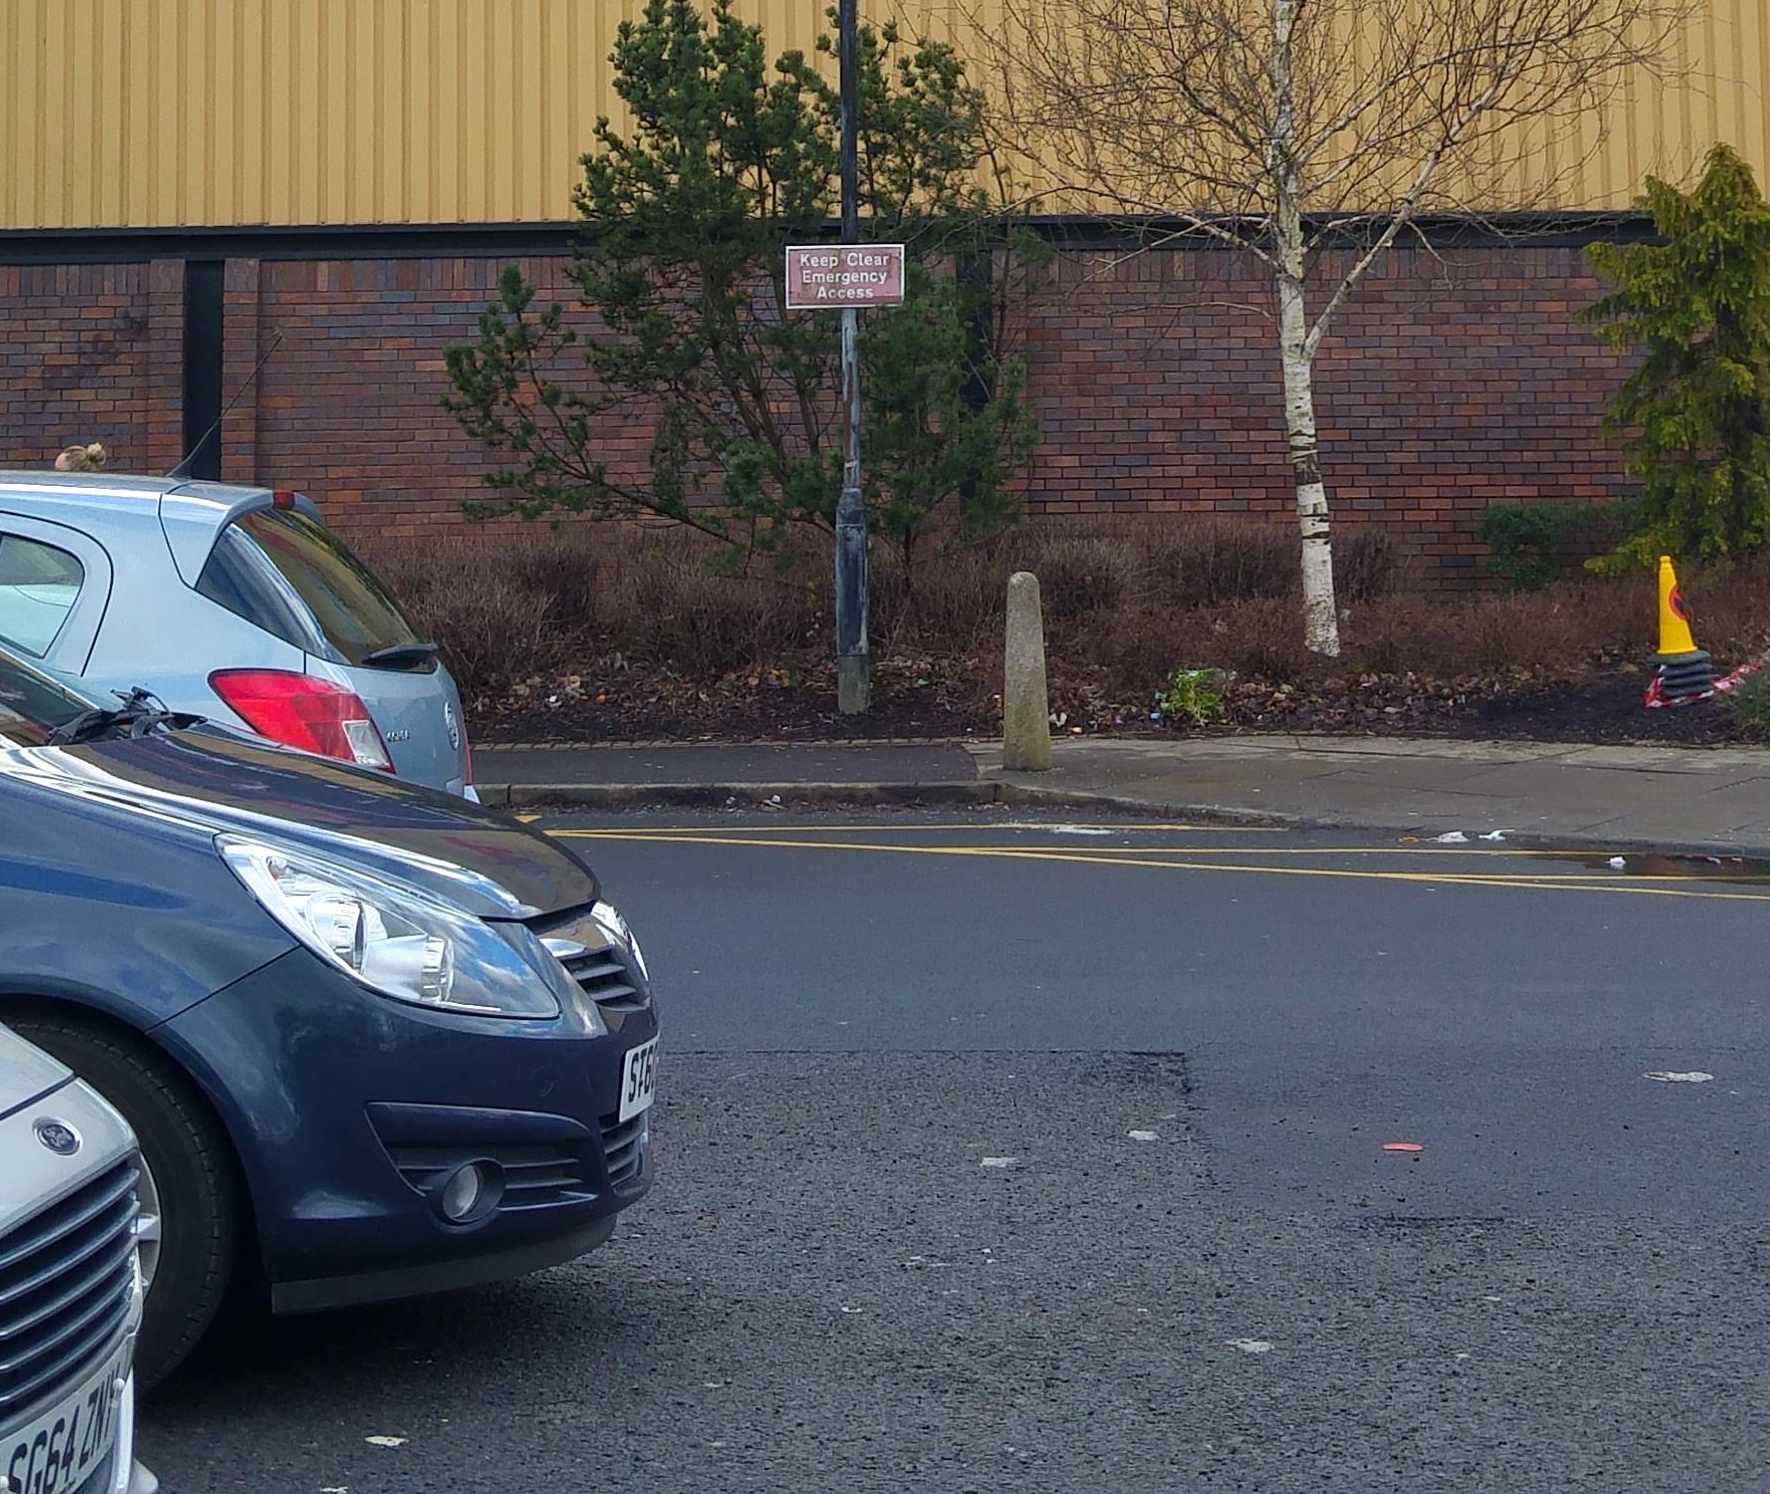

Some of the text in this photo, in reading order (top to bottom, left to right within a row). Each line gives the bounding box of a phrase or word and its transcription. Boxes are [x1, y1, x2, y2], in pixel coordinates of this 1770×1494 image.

[800, 253, 889, 269] Keep Clear
[802, 270, 887, 285] Emergency
[816, 287, 874, 299] Access
